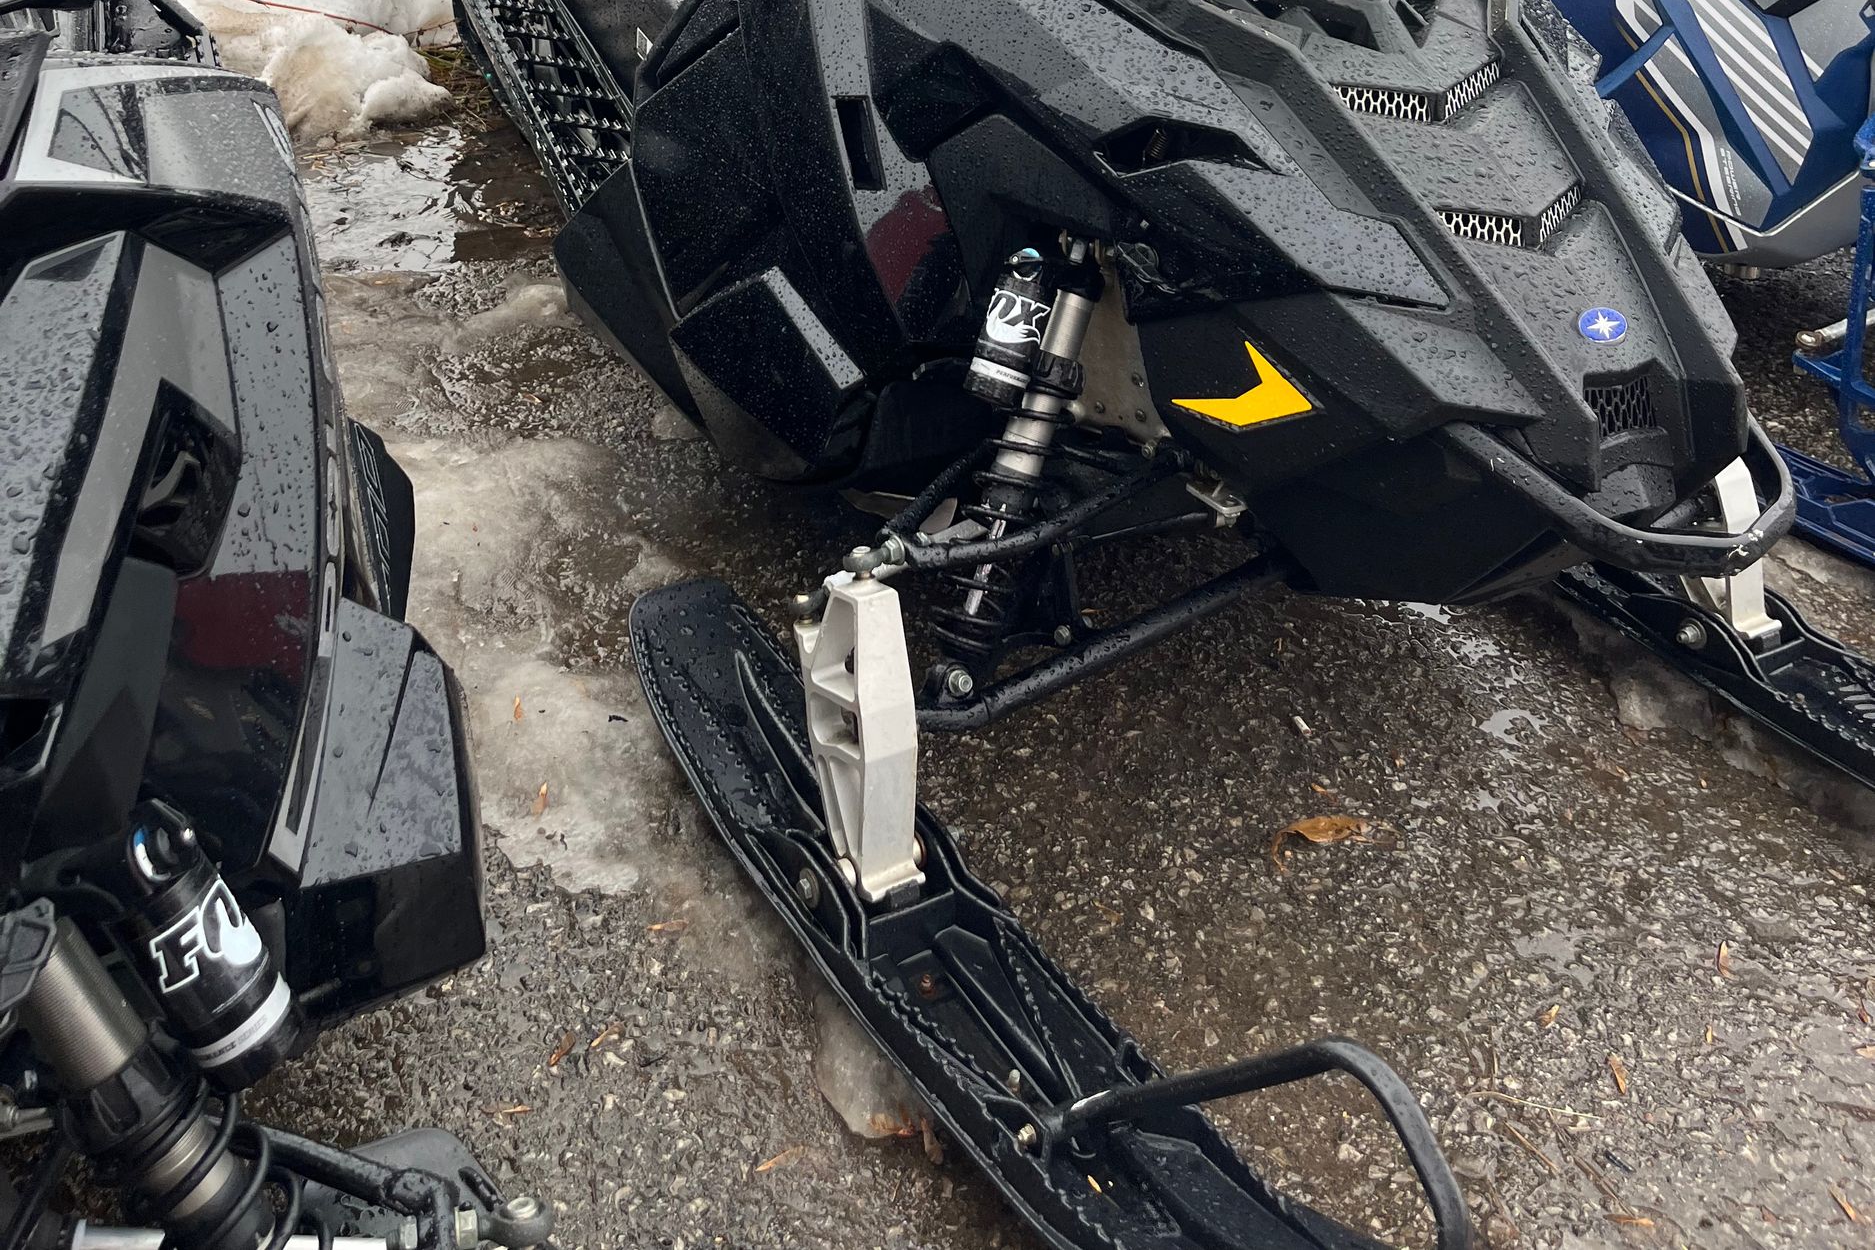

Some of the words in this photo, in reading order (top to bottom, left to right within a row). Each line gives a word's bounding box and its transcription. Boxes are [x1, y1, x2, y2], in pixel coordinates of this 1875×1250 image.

[1726, 150, 1741, 200] POWER
[986, 288, 1051, 336] OX
[149, 876, 263, 994] FO
